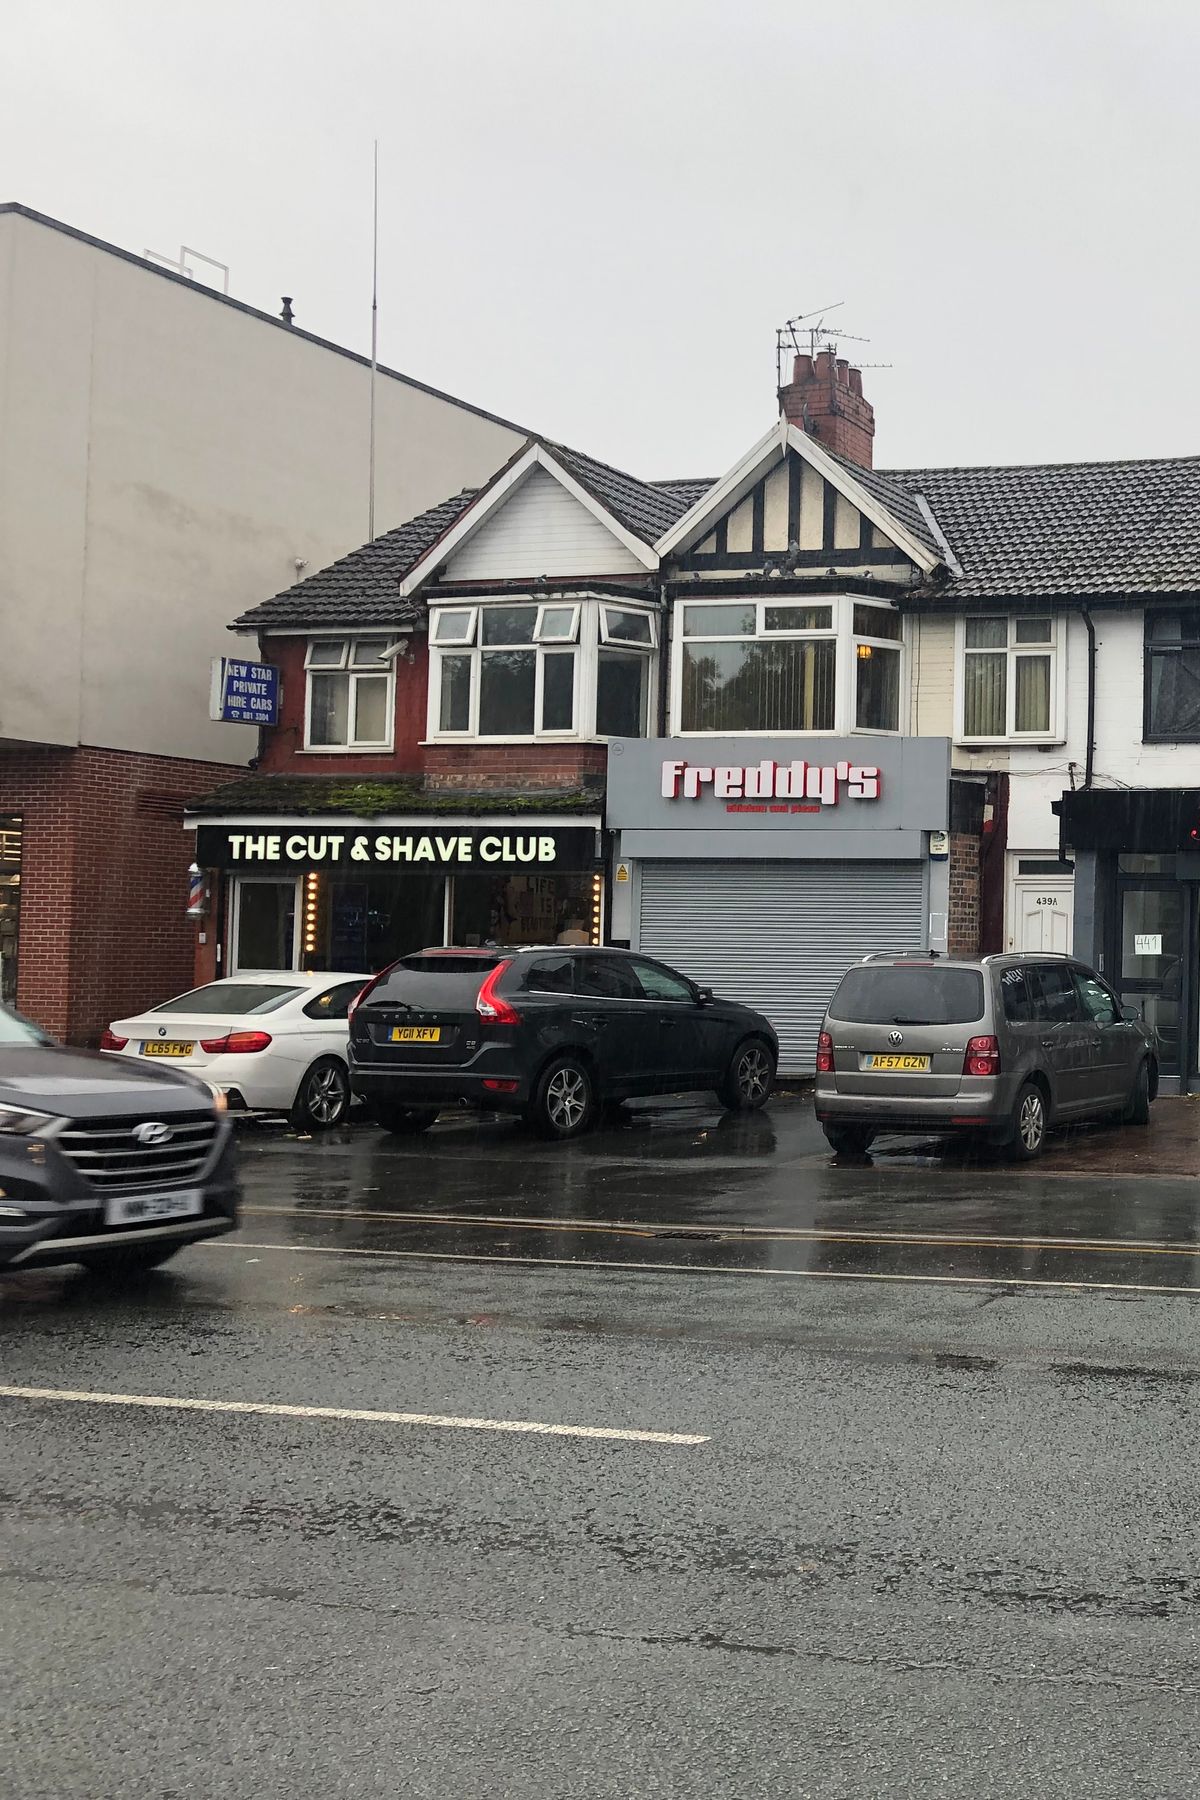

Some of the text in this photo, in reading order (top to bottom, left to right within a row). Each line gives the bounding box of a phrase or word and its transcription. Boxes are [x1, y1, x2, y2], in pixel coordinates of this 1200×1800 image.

[228, 664, 272, 681] NEW STAR
[233, 680, 268, 695] PRIVATE
[227, 695, 273, 711] HIRE CARS
[661, 760, 881, 805] Freddy's
[228, 835, 557, 862] THE CUT & SHAVE CLUB
[1036, 897, 1058, 906] 439A
[398, 1028, 435, 1039] YG11 XFV
[145, 1043, 192, 1054] LC65 FWG
[873, 1056, 926, 1068] AF57 GZN
